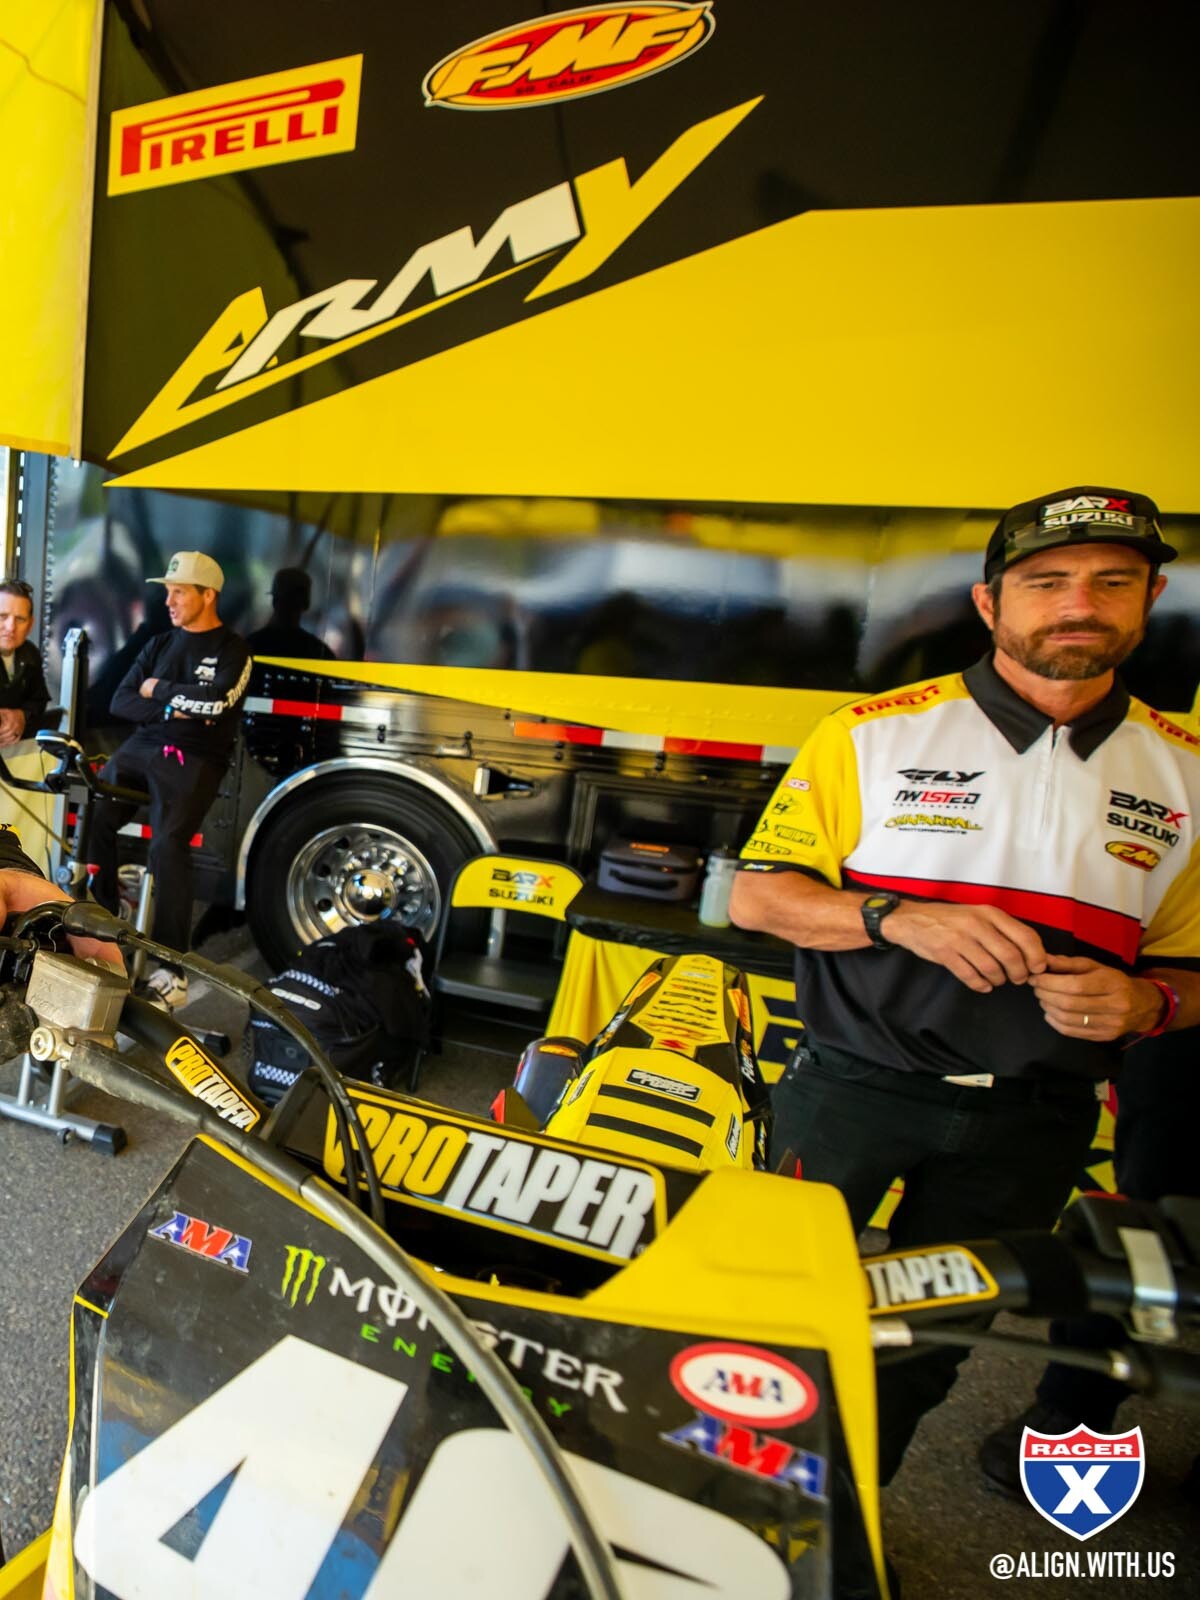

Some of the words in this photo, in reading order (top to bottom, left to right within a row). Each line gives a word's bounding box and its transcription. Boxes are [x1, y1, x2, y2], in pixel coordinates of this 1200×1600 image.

[431, 6, 705, 101] FMF
[120, 78, 346, 177] PIRELLI
[107, 95, 765, 460] ARMY
[1043, 511, 1134, 529] SUZUKI
[1044, 495, 1130, 517] BARX
[896, 769, 987, 783] FLY
[1106, 812, 1180, 848] SUZUKI
[1109, 789, 1190, 830] BARX
[488, 887, 554, 906] SUZUKI
[491, 867, 556, 889] BARX
[170, 1043, 258, 1130] PROTAPER
[343, 1102, 656, 1260] PROTAPER
[148, 1210, 253, 1273] AMA
[328, 1267, 629, 1413] MOSTER
[360, 1323, 572, 1418] ENEY
[703, 1368, 783, 1402] AMA
[659, 1412, 831, 1503] AMA
